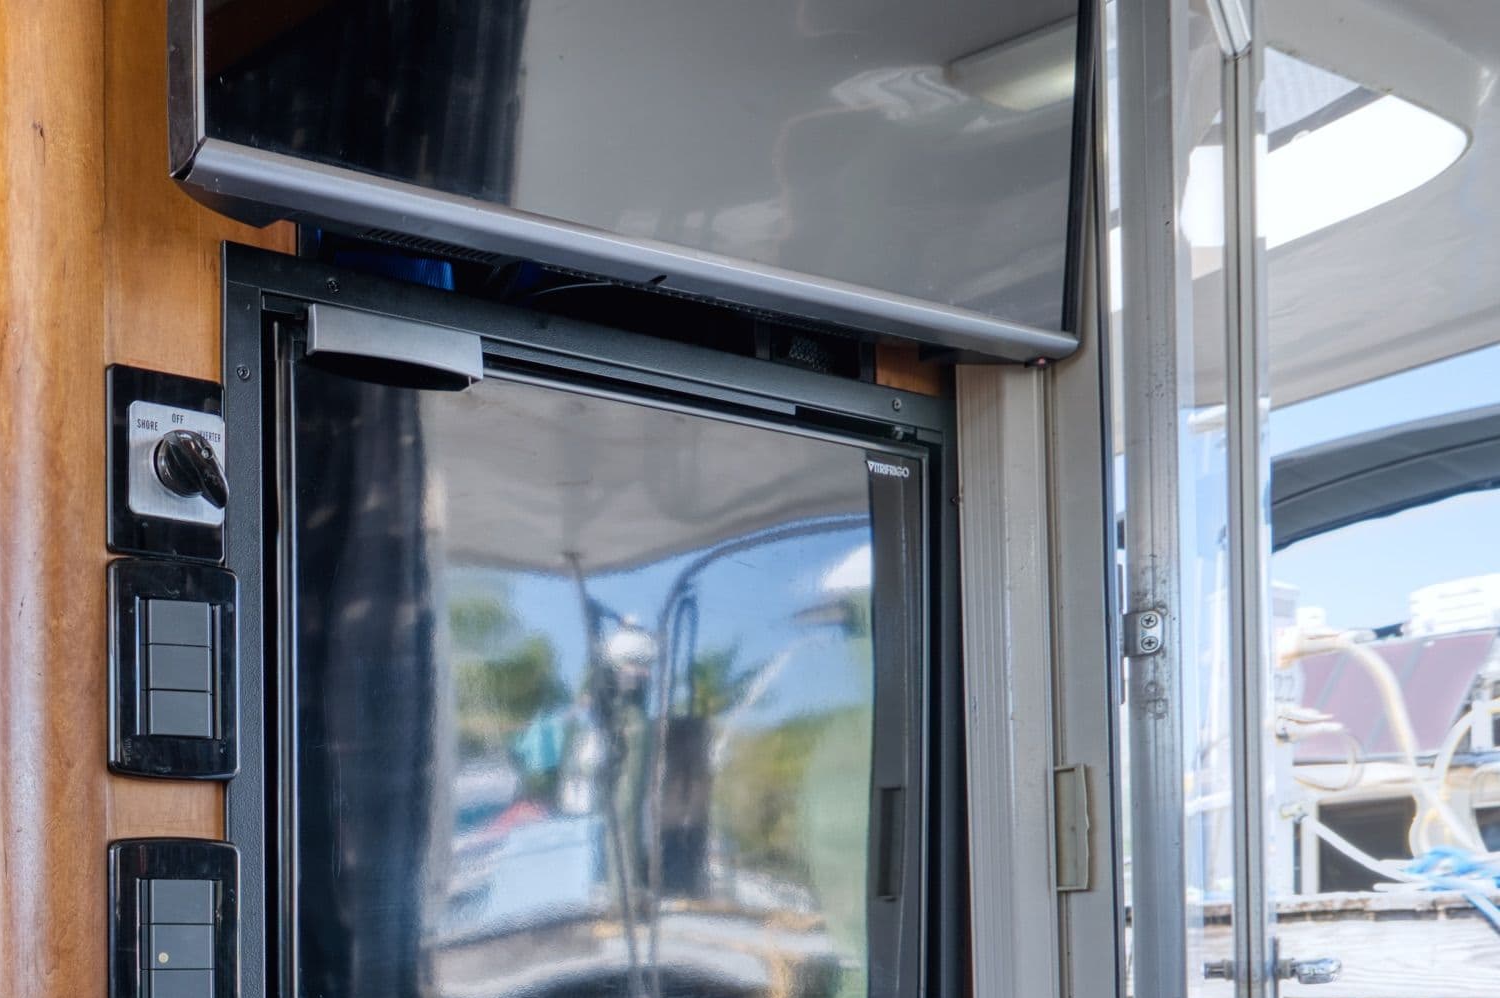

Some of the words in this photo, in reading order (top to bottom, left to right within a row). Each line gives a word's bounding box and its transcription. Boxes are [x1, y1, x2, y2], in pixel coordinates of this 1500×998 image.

[137, 418, 158, 431] SHORE
[171, 413, 184, 424] OFF
[201, 431, 221, 443] VERTER
